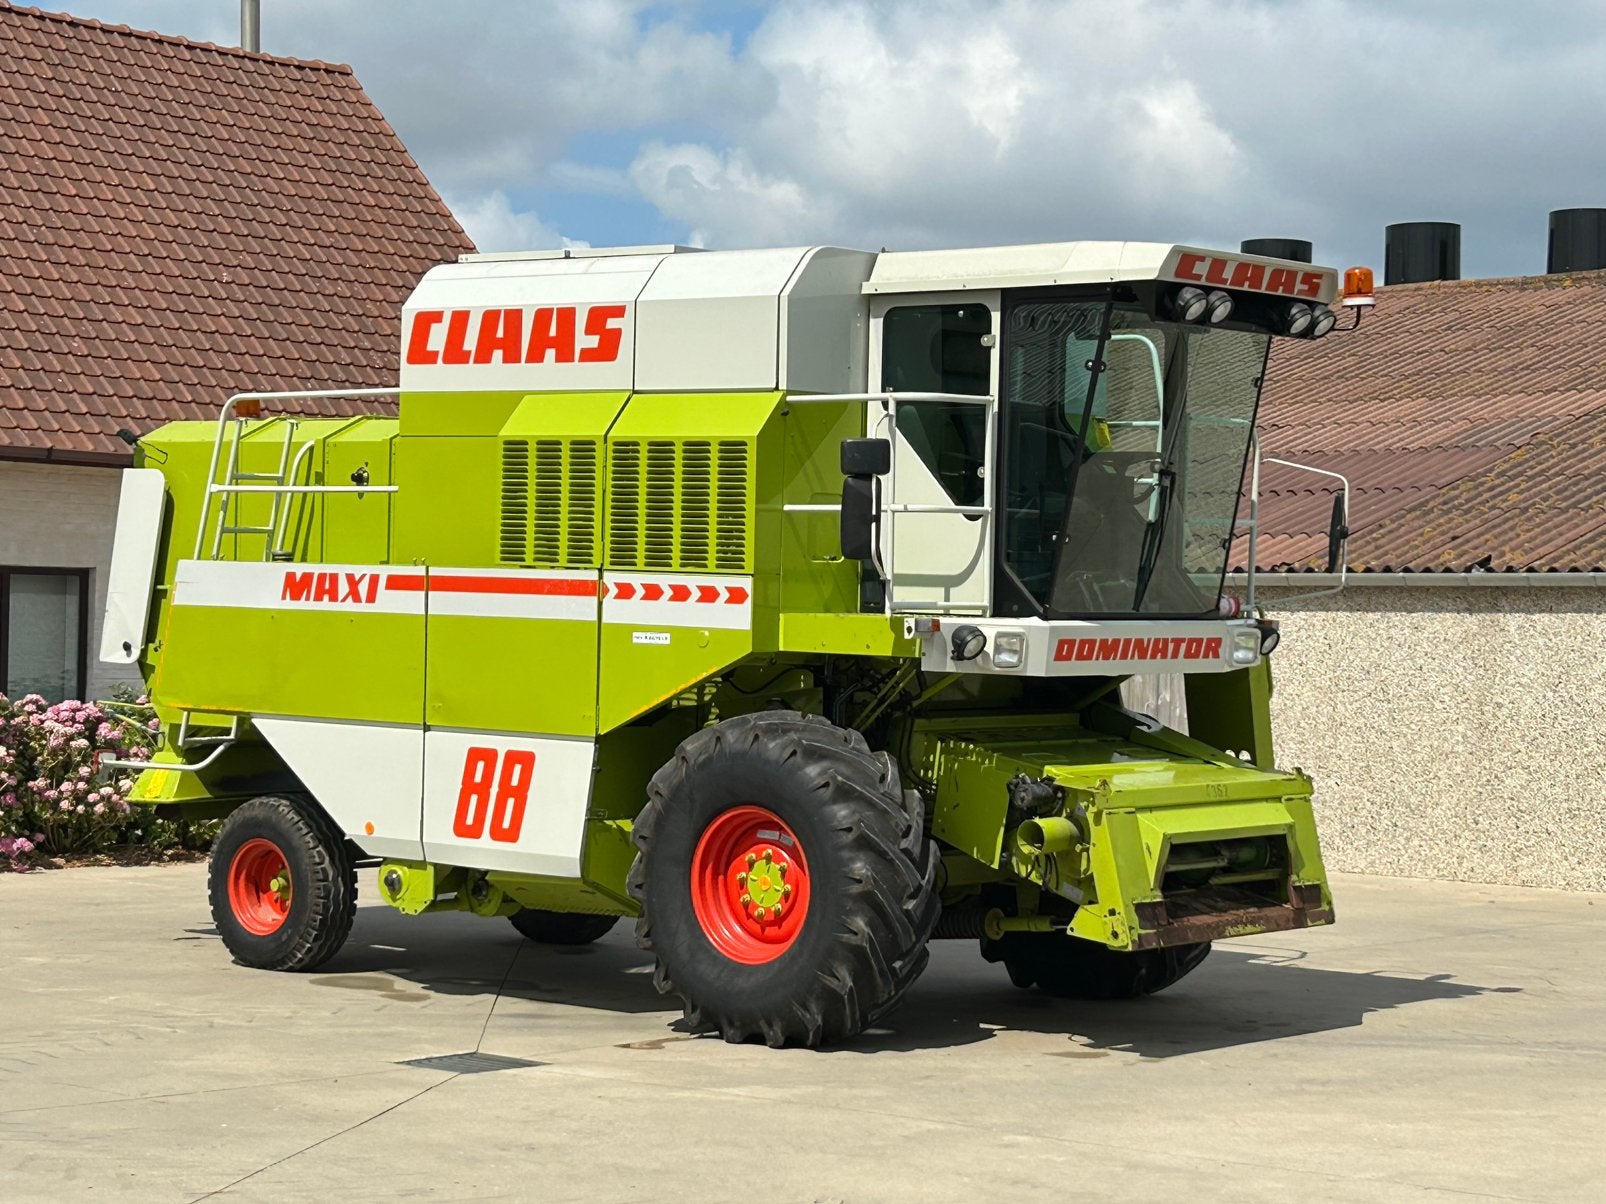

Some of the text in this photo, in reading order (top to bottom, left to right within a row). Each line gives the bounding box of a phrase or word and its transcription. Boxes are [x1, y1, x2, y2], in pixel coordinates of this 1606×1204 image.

[1174, 253, 1323, 298] CLAAS
[406, 305, 627, 365] CLAAS
[281, 571, 380, 604] MAXI
[1053, 637, 1222, 662] DOMINATOR
[453, 746, 536, 843] 88
